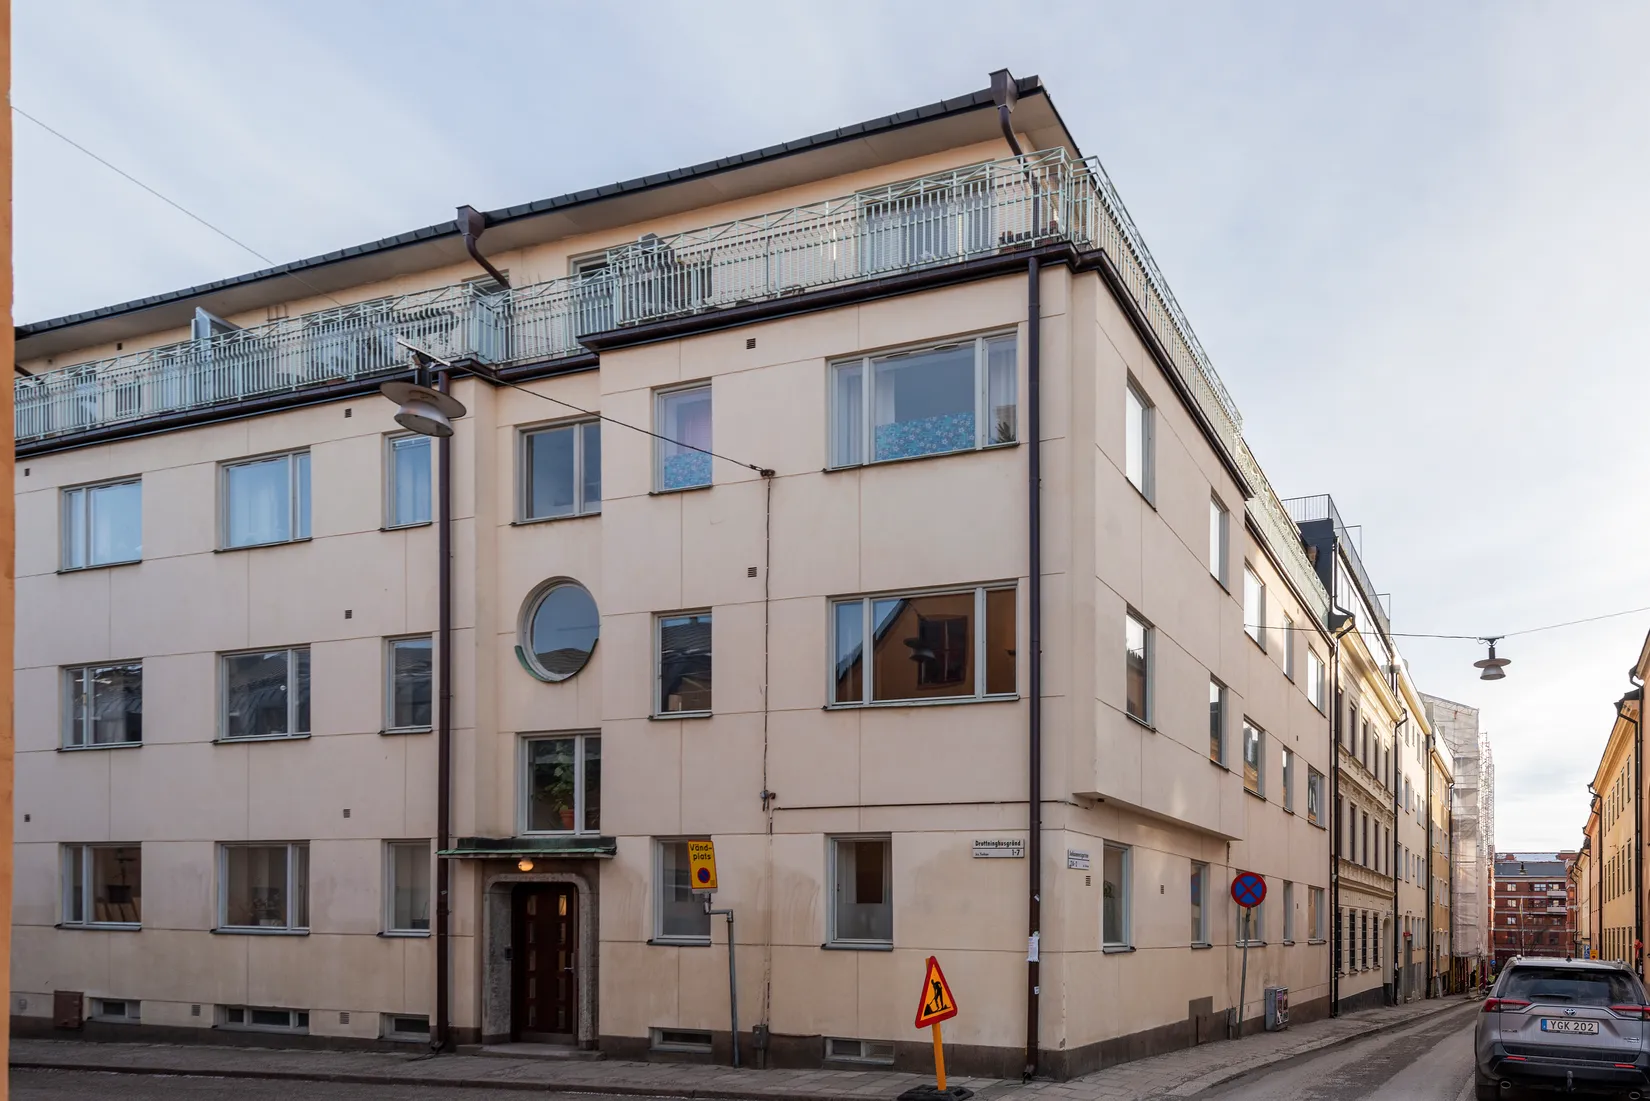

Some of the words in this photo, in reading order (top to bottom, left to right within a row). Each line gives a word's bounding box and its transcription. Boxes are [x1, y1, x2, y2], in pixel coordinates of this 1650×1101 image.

[975, 840, 1021, 848] Drottninghusgränd
[693, 853, 711, 861] plats
[1550, 1020, 1570, 1030] YGK
[1573, 1022, 1594, 1031] 202
